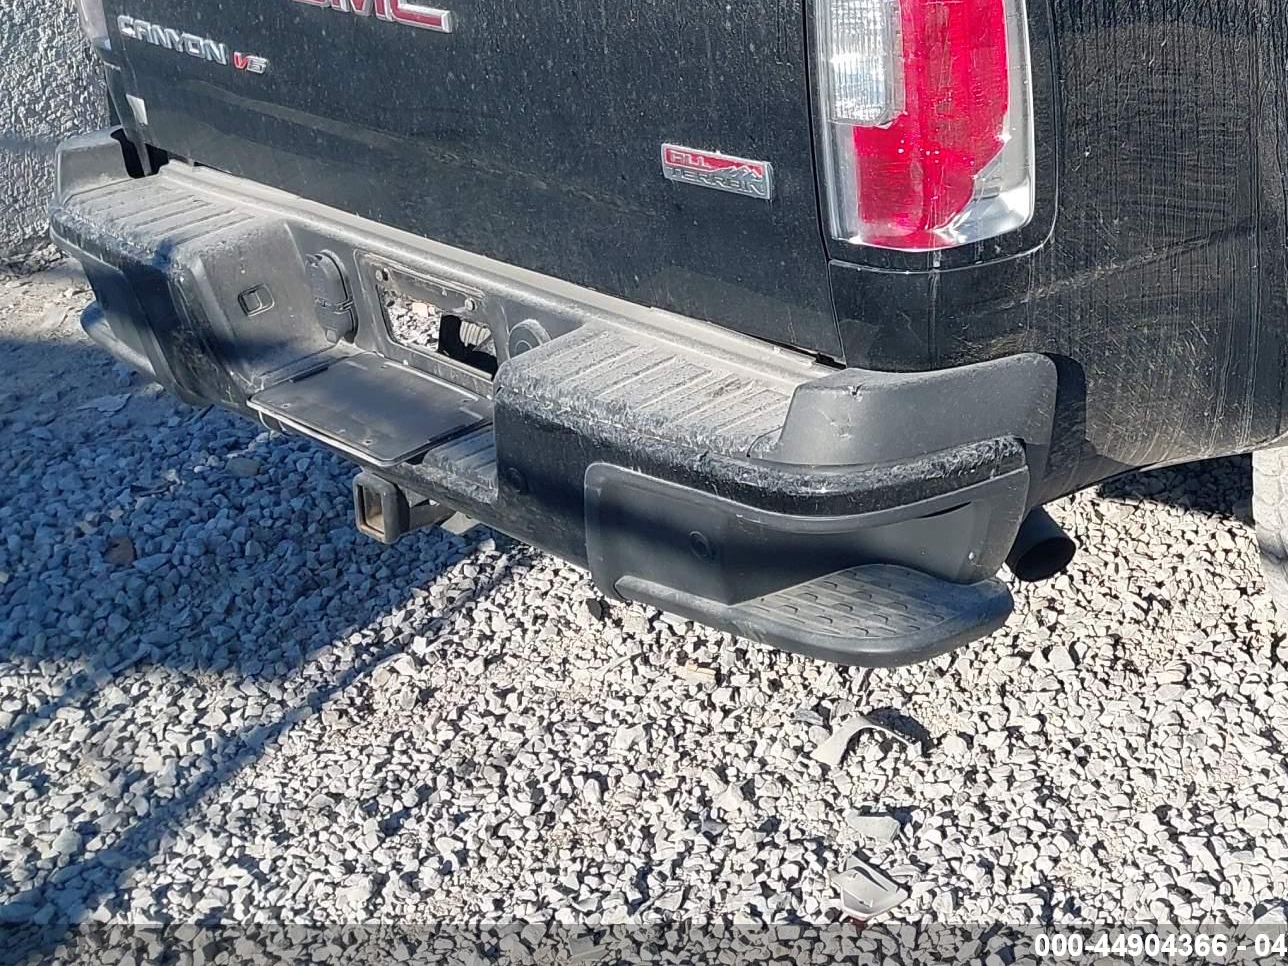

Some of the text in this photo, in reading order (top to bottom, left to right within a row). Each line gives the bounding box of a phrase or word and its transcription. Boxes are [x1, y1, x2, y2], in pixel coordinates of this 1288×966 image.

[117, 14, 269, 75] CANYON V6
[669, 149, 713, 169] ALL
[664, 166, 766, 196] TERRAIN
